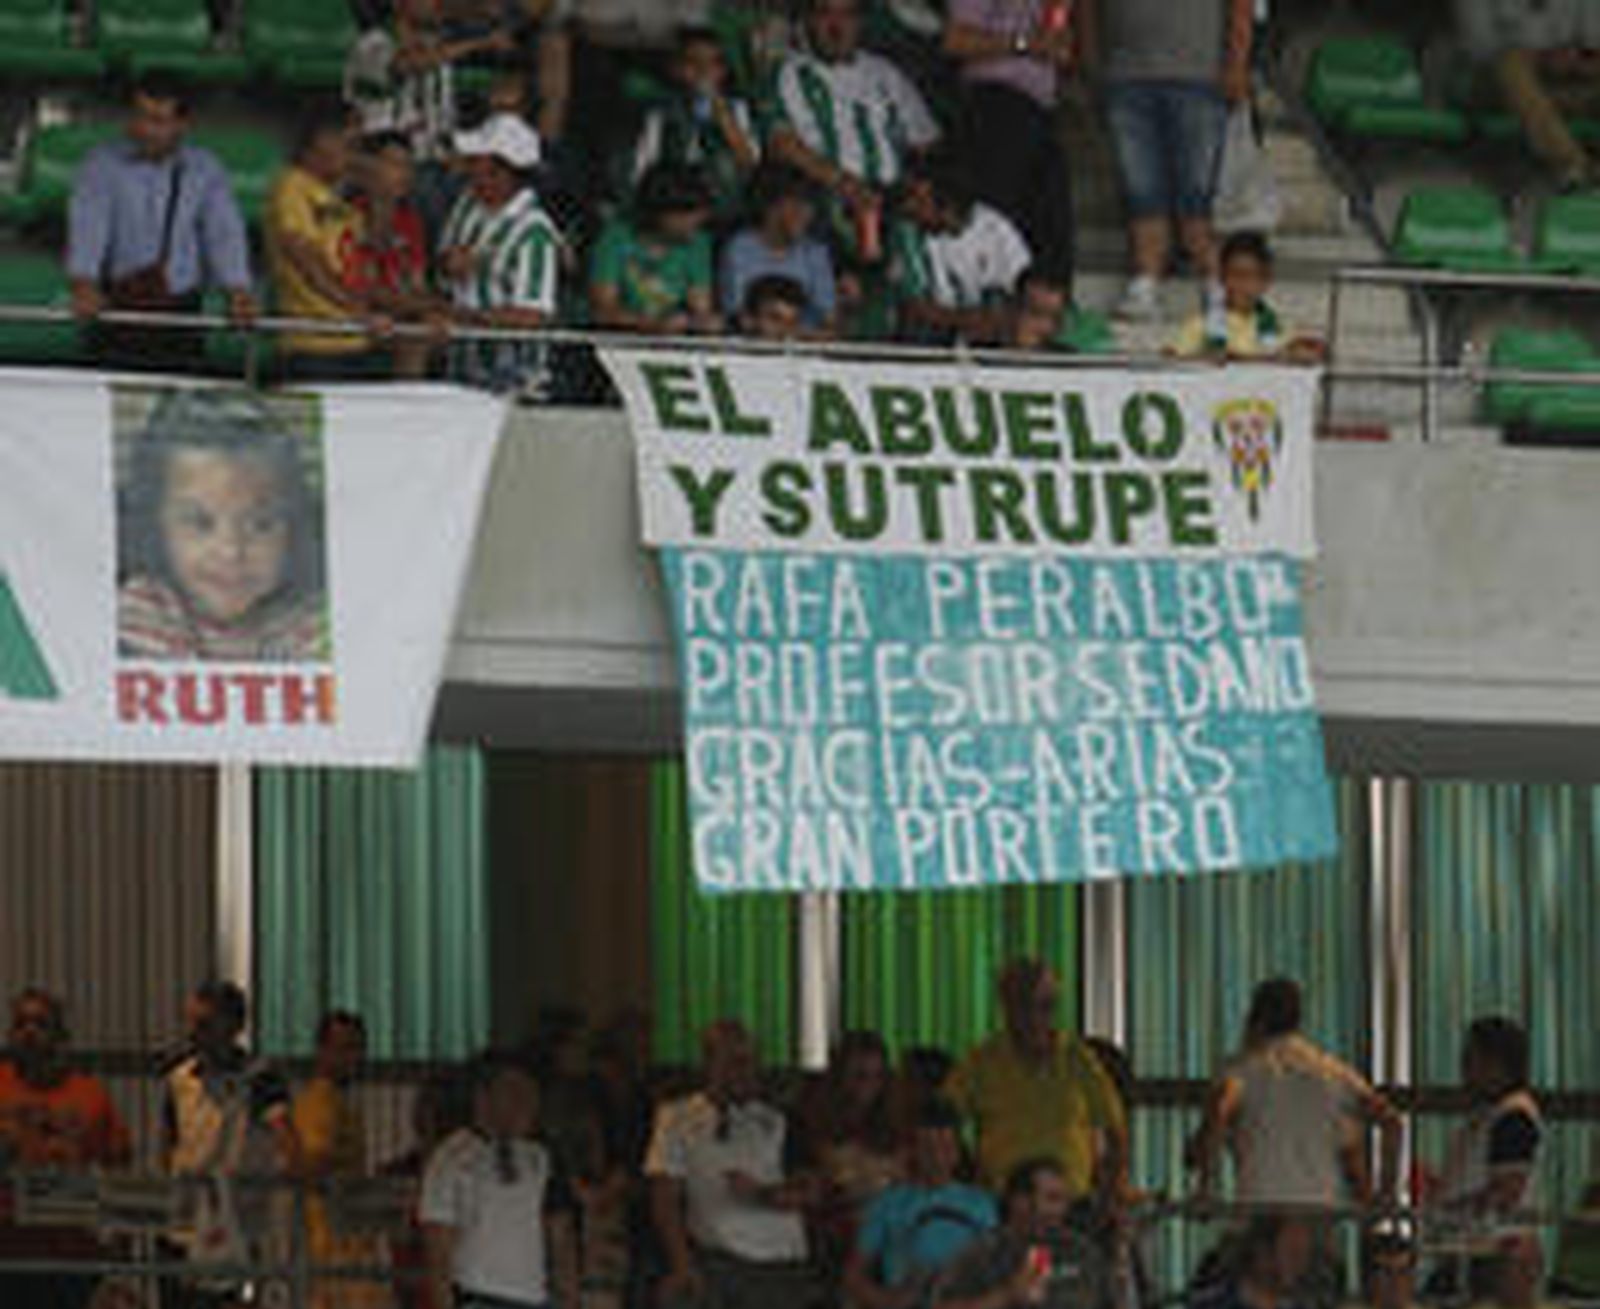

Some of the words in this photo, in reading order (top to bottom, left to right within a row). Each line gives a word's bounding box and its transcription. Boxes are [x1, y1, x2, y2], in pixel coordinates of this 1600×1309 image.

[639, 362, 771, 436] EL
[807, 381, 1185, 462] ABUELO
[669, 463, 736, 537] Y
[683, 553, 871, 641] RAFA
[925, 556, 1269, 641] PERALBO
[115, 672, 337, 726] RUTH
[692, 808, 876, 890] GRAN
[897, 796, 1242, 888] PORTERO
